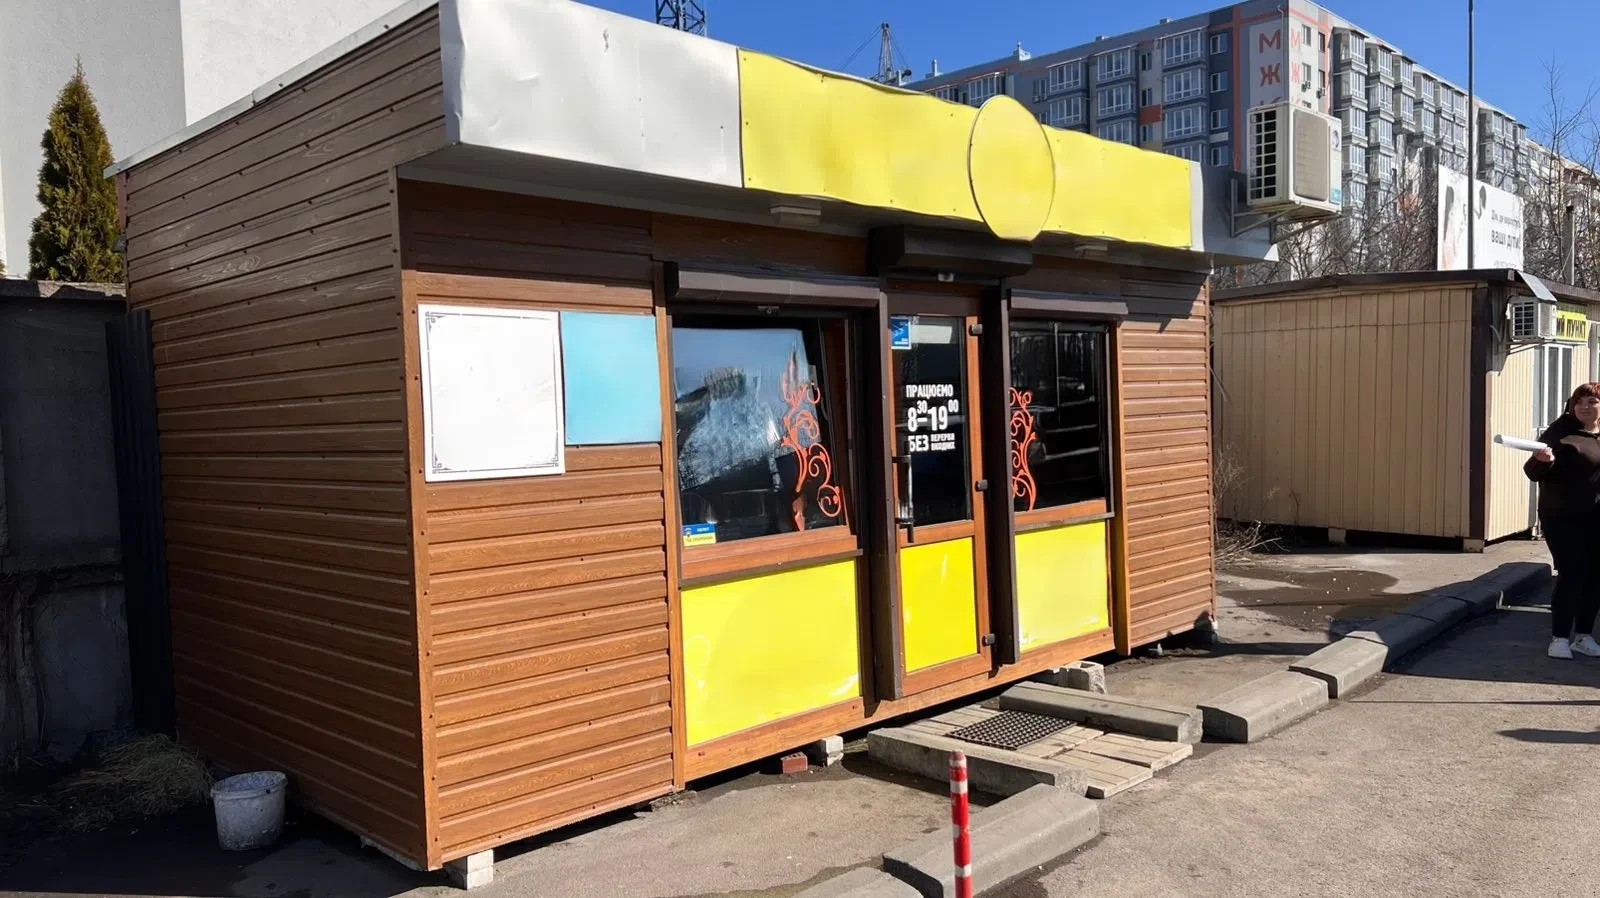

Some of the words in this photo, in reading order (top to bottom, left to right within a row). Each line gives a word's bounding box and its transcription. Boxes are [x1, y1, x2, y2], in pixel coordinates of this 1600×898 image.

[1566, 318, 1586, 339] ПУНКТ
[906, 384, 953, 399] ПРАЦЮЄМО
[908, 435, 929, 452] БЕЗ
